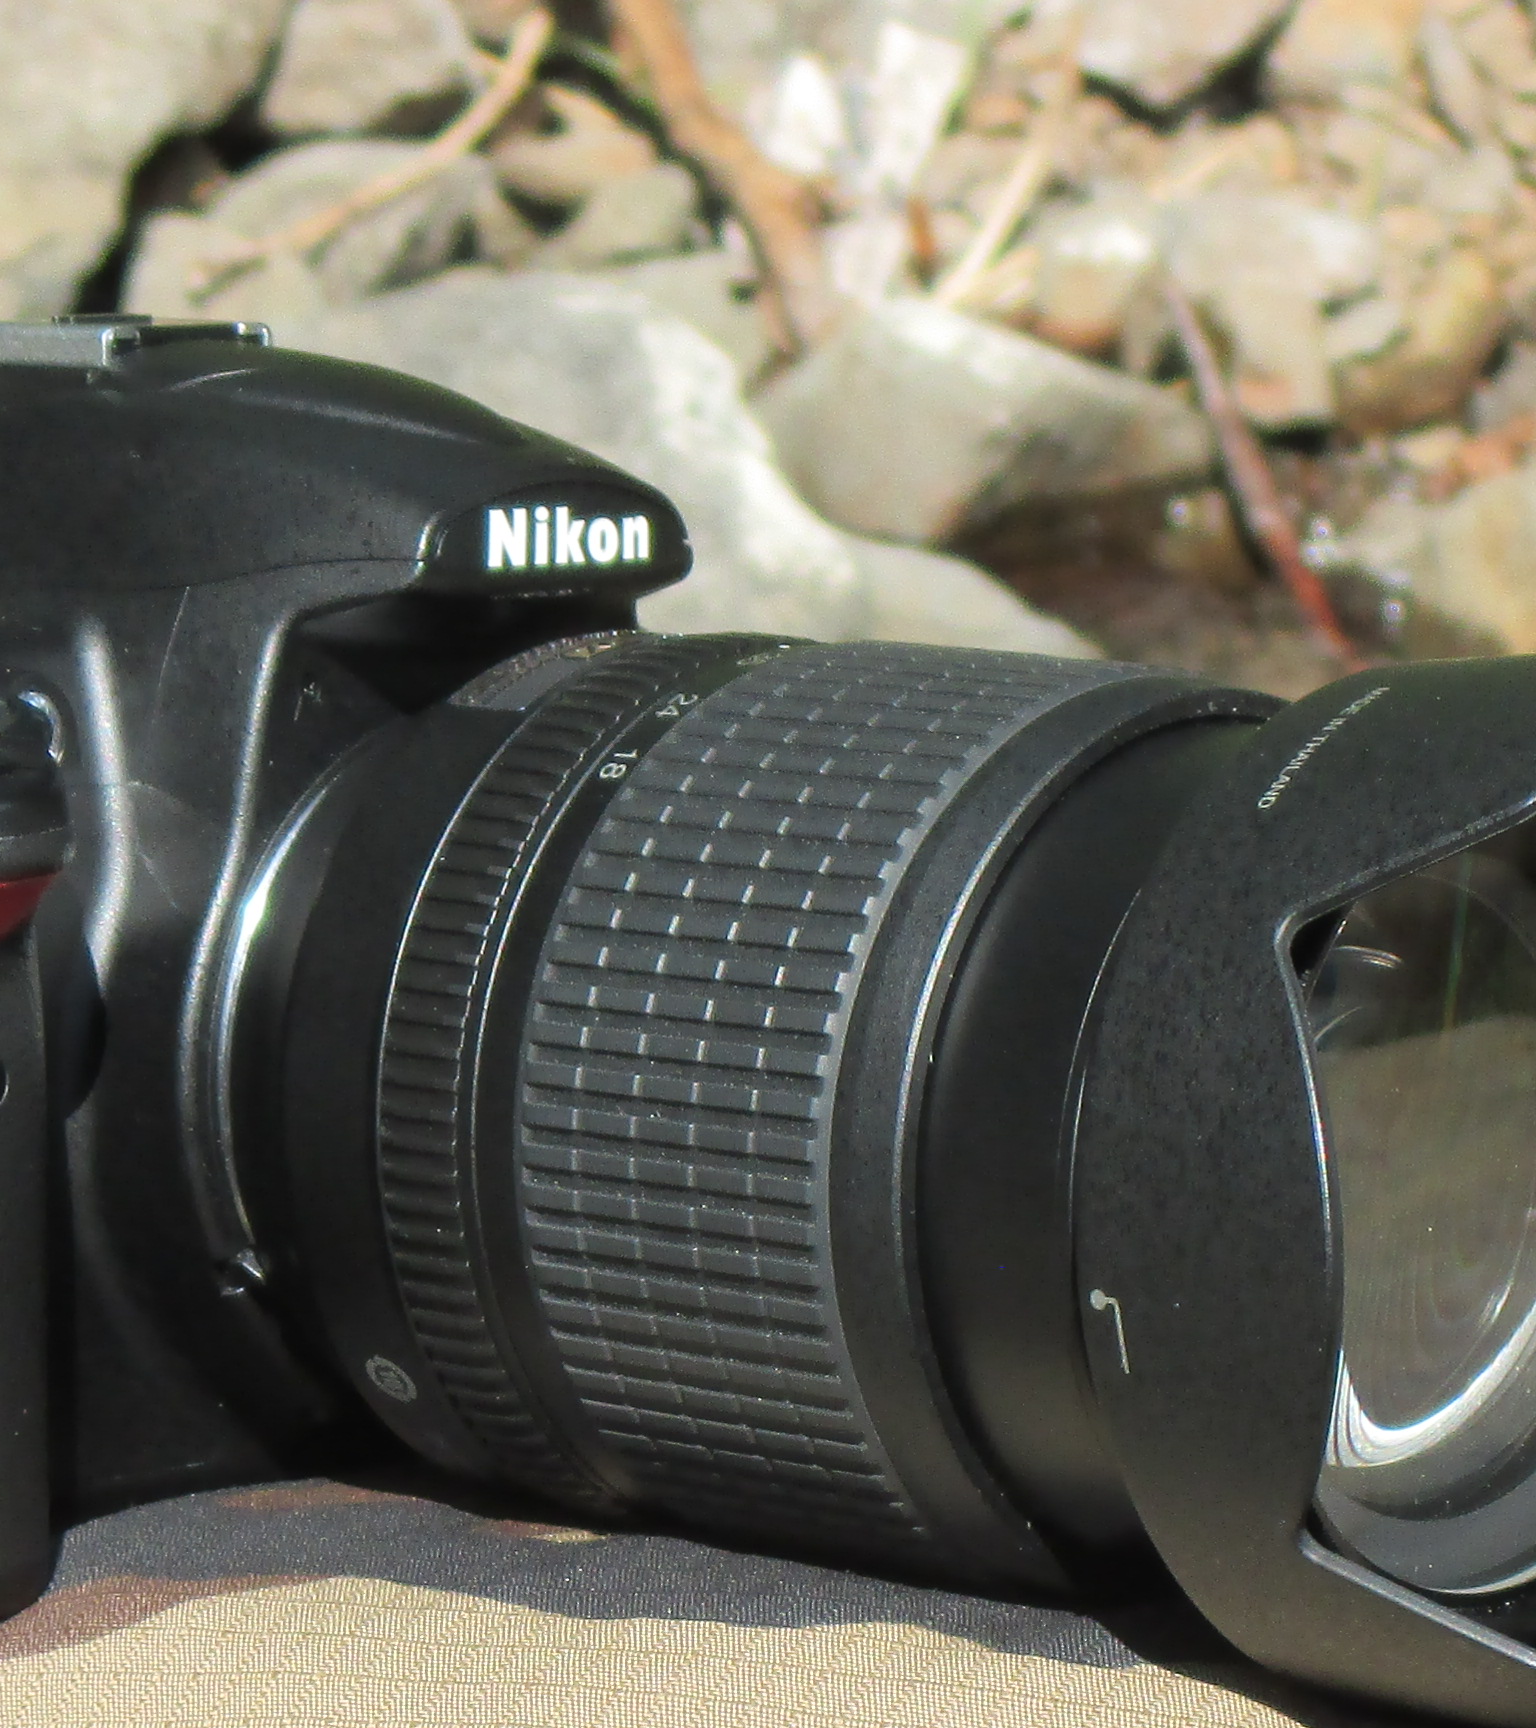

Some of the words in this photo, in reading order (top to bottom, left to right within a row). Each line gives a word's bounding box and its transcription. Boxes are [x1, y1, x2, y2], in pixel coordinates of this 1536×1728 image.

[486, 505, 651, 569] Nikon
[655, 692, 699, 718] 24
[599, 748, 639, 779] 18
[1257, 734, 1330, 809] THAILAND
